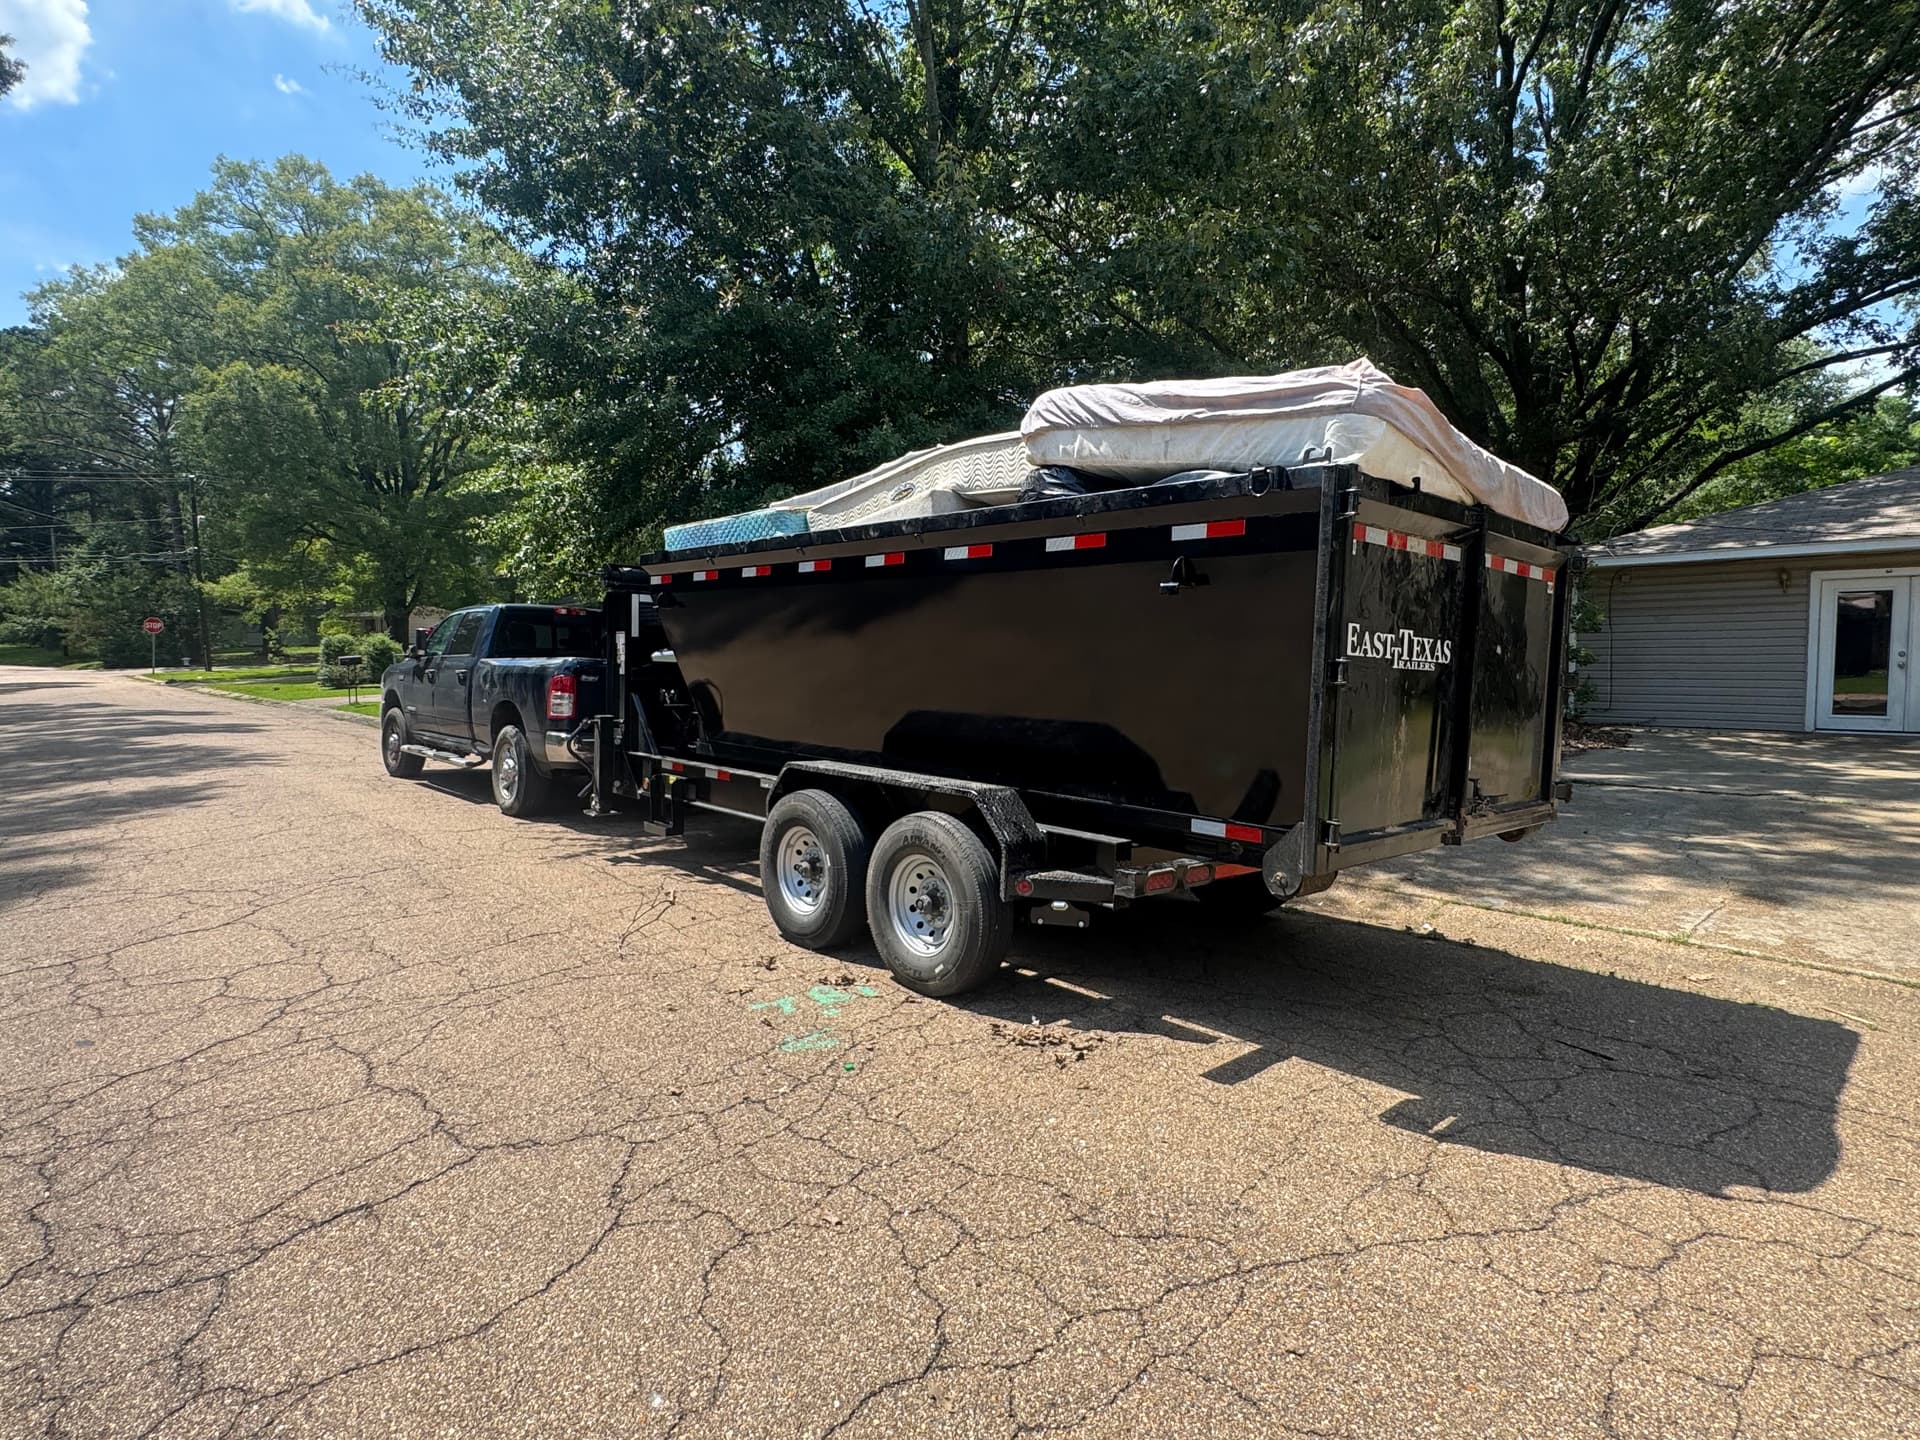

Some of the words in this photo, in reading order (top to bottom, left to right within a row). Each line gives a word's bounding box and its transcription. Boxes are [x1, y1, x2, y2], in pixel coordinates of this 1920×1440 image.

[1346, 622, 1396, 659] EAST
[1399, 628, 1451, 664] TEXAS
[1391, 647, 1435, 671] TRAILERS
